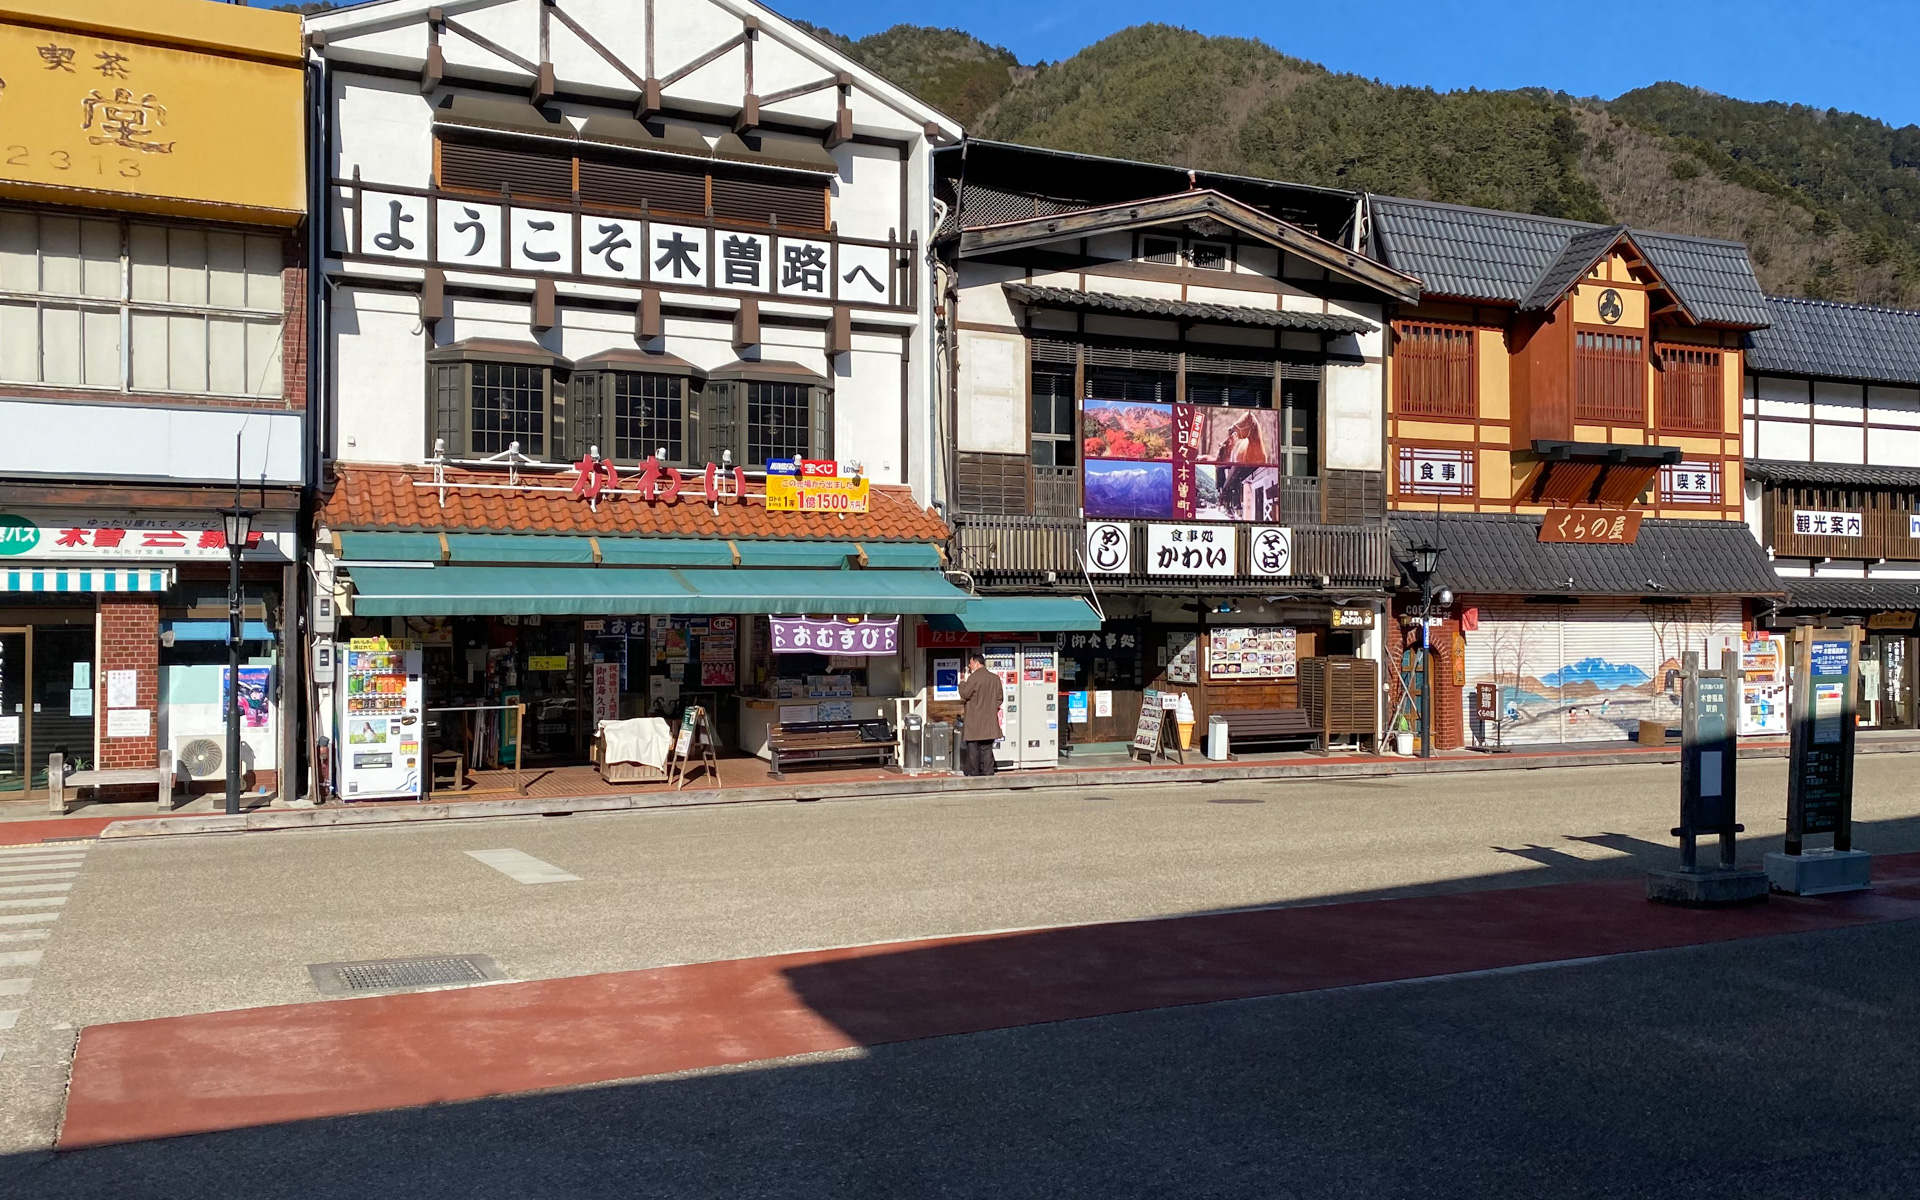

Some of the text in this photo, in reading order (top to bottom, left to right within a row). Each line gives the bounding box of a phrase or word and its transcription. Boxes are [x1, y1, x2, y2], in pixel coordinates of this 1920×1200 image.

[36, 42, 132, 81] 喫茶
[372, 199, 887, 297] ようこそ木曽路へ
[804, 462, 834, 475] 宝くじ
[1176, 405, 1194, 519] いい日々、木曽町。
[1418, 461, 1457, 482] 食事
[572, 453, 746, 499] かわい
[1676, 473, 1708, 492] 喫茶
[1170, 528, 1214, 543] 食事処
[1555, 513, 1626, 542] くらの屋
[1796, 513, 1863, 536] 観光案内
[55, 526, 126, 548] 木曽
[1096, 528, 1121, 568] めし
[1156, 544, 1228, 569] かわい
[1261, 533, 1287, 568] そば
[1406, 604, 1443, 615] COFEE
[792, 625, 880, 650] おむすび
[1070, 632, 1136, 650] 御食事処
[1700, 694, 1724, 703] 木曽福島
[1705, 704, 1718, 713] 駅前
